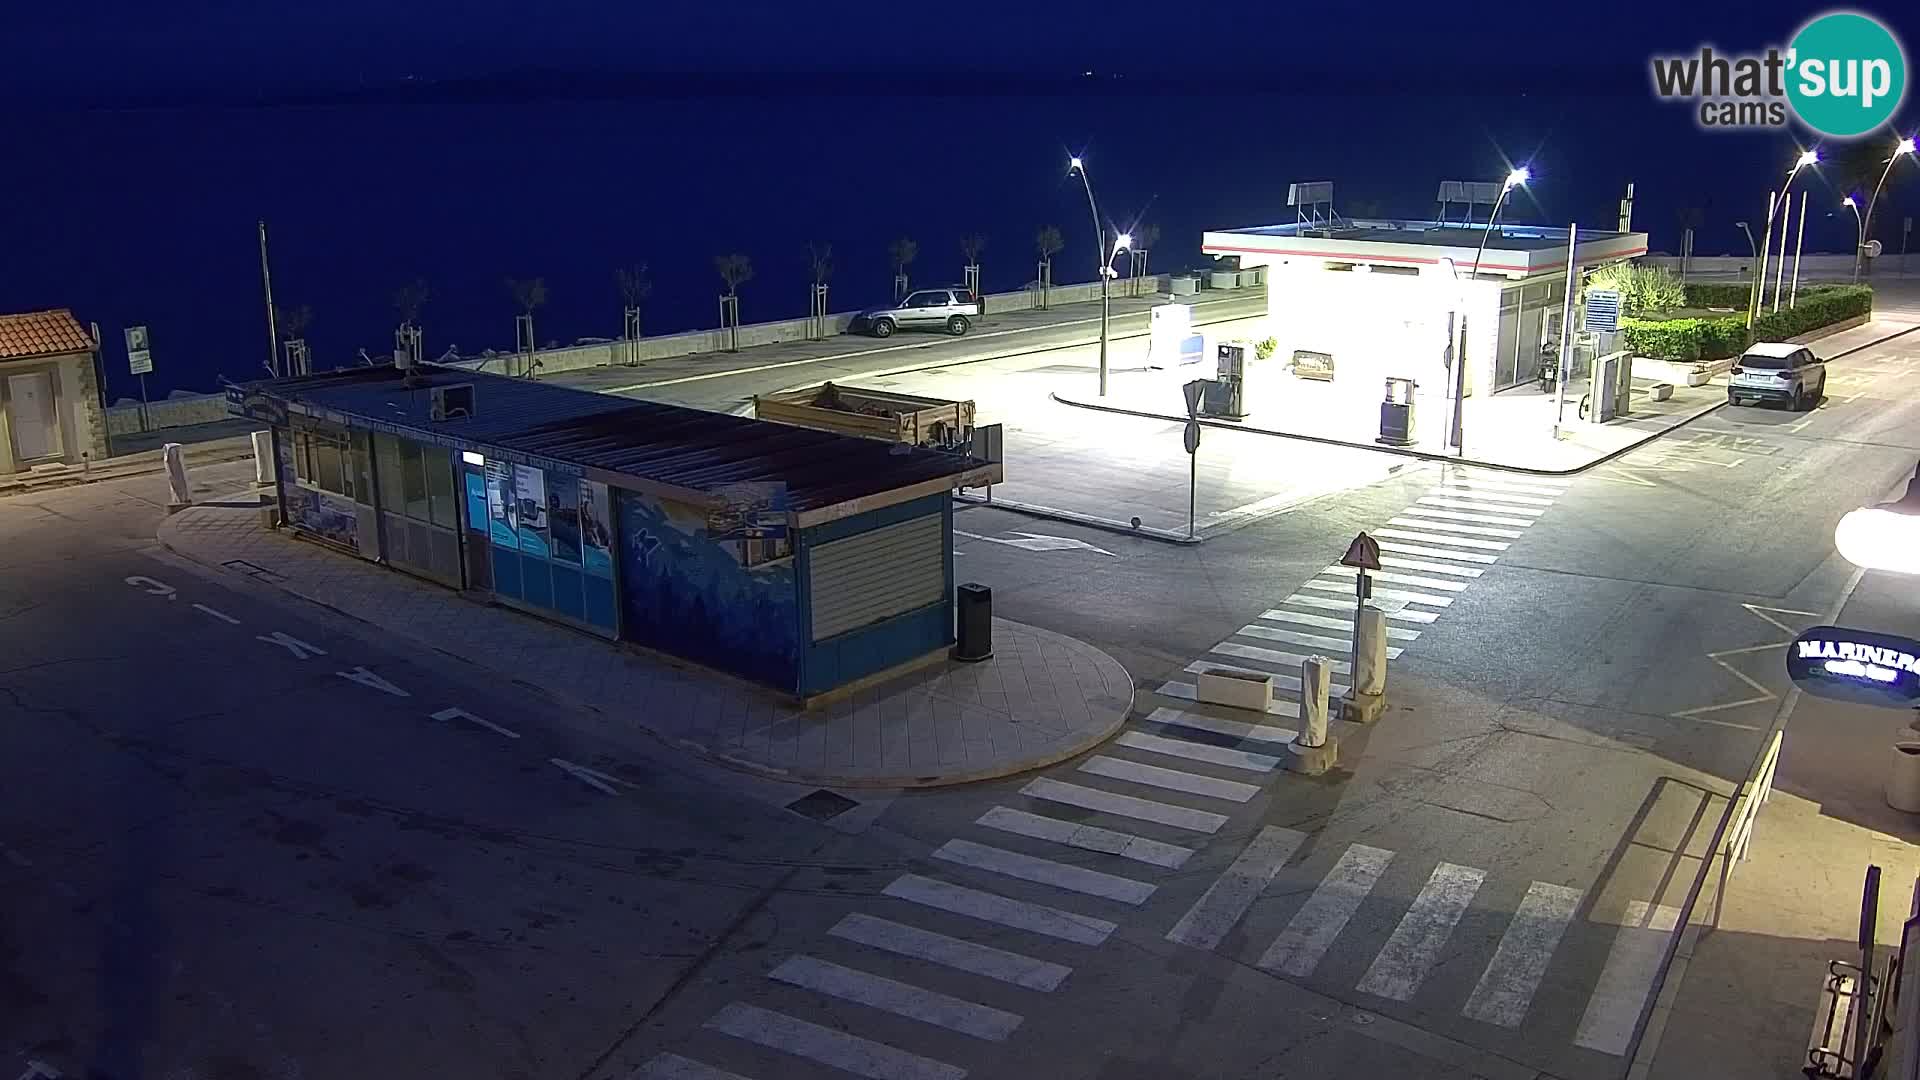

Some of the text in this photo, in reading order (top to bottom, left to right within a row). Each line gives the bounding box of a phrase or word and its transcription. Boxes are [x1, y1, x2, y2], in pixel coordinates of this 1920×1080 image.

[131, 331, 144, 348] P
[528, 457, 553, 471] TICKET
[555, 462, 584, 477] OFFICE
